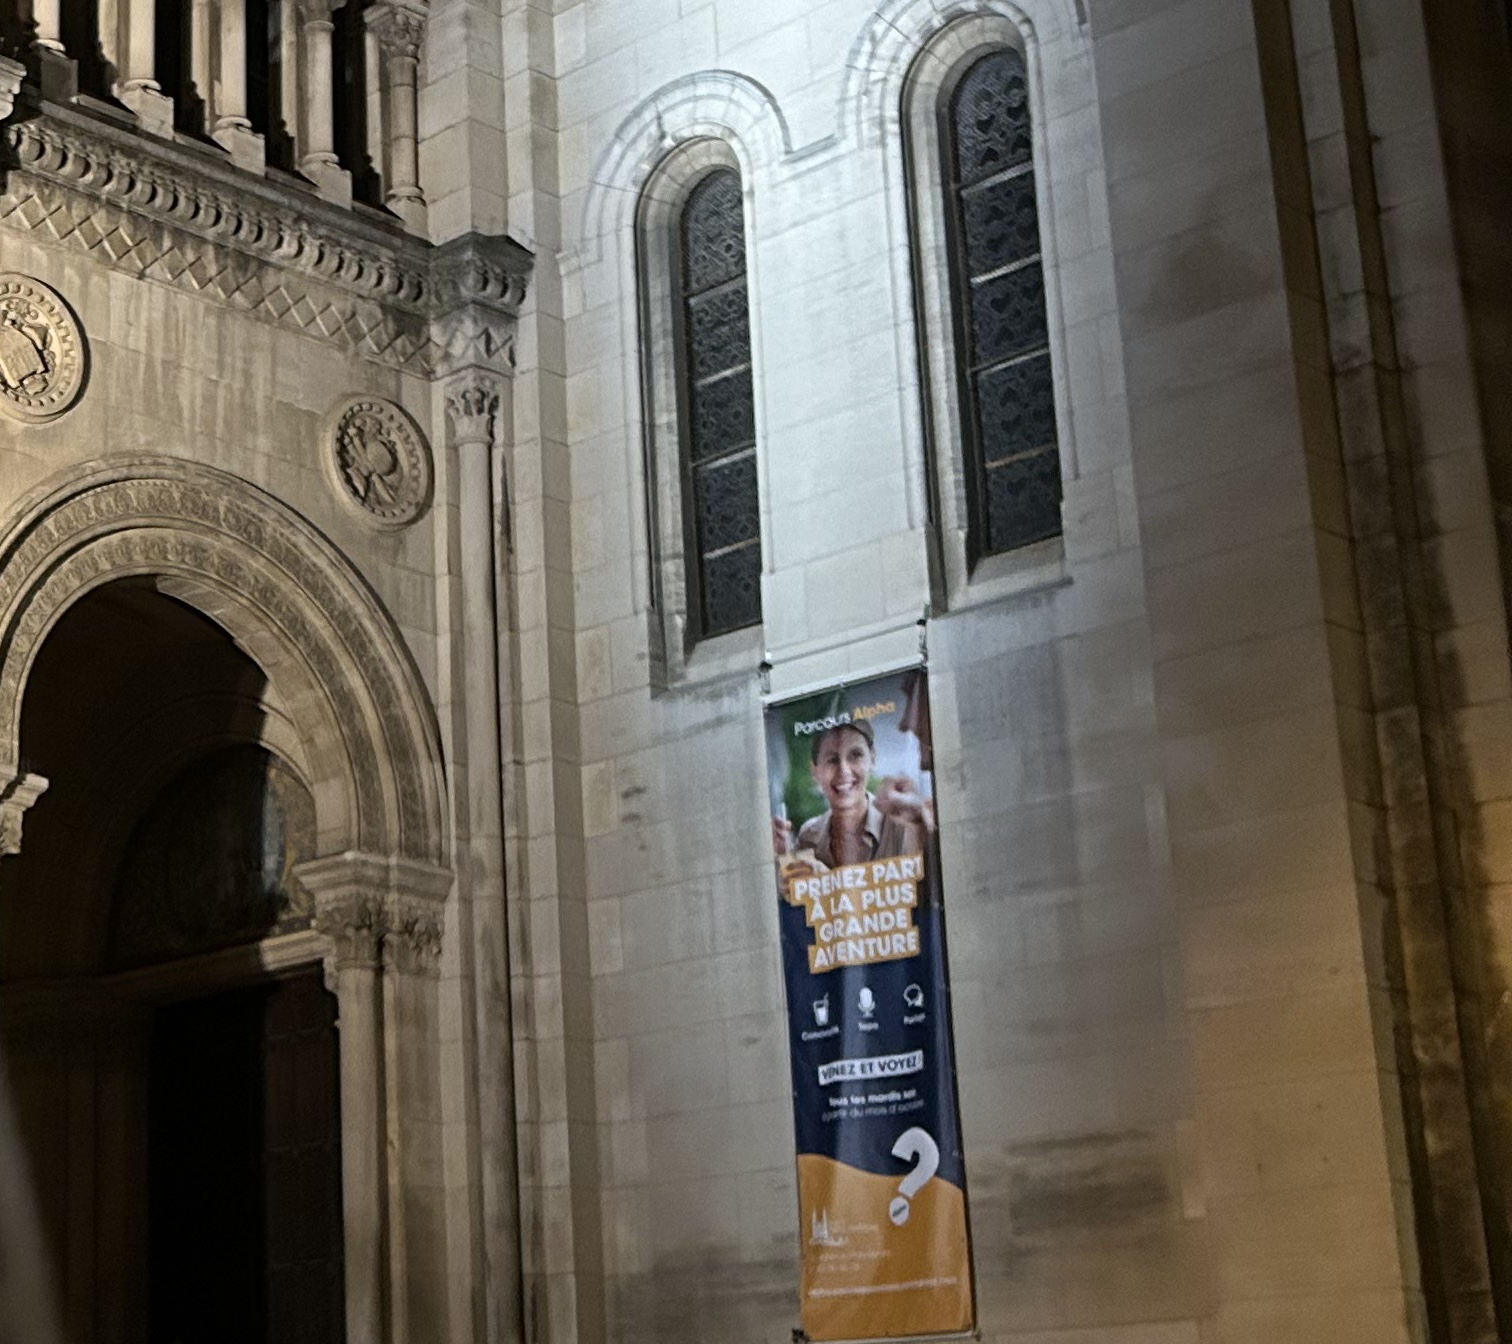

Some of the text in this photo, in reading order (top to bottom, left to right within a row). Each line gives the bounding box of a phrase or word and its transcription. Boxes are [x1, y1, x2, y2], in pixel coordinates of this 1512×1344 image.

[794, 856, 922, 901] PRENEZ PART
[830, 894, 853, 915] LA
[861, 882, 914, 910] PLUS
[819, 908, 907, 942] GRANDE
[814, 930, 918, 968] AVENTURE
[860, 1061, 874, 1074] ET
